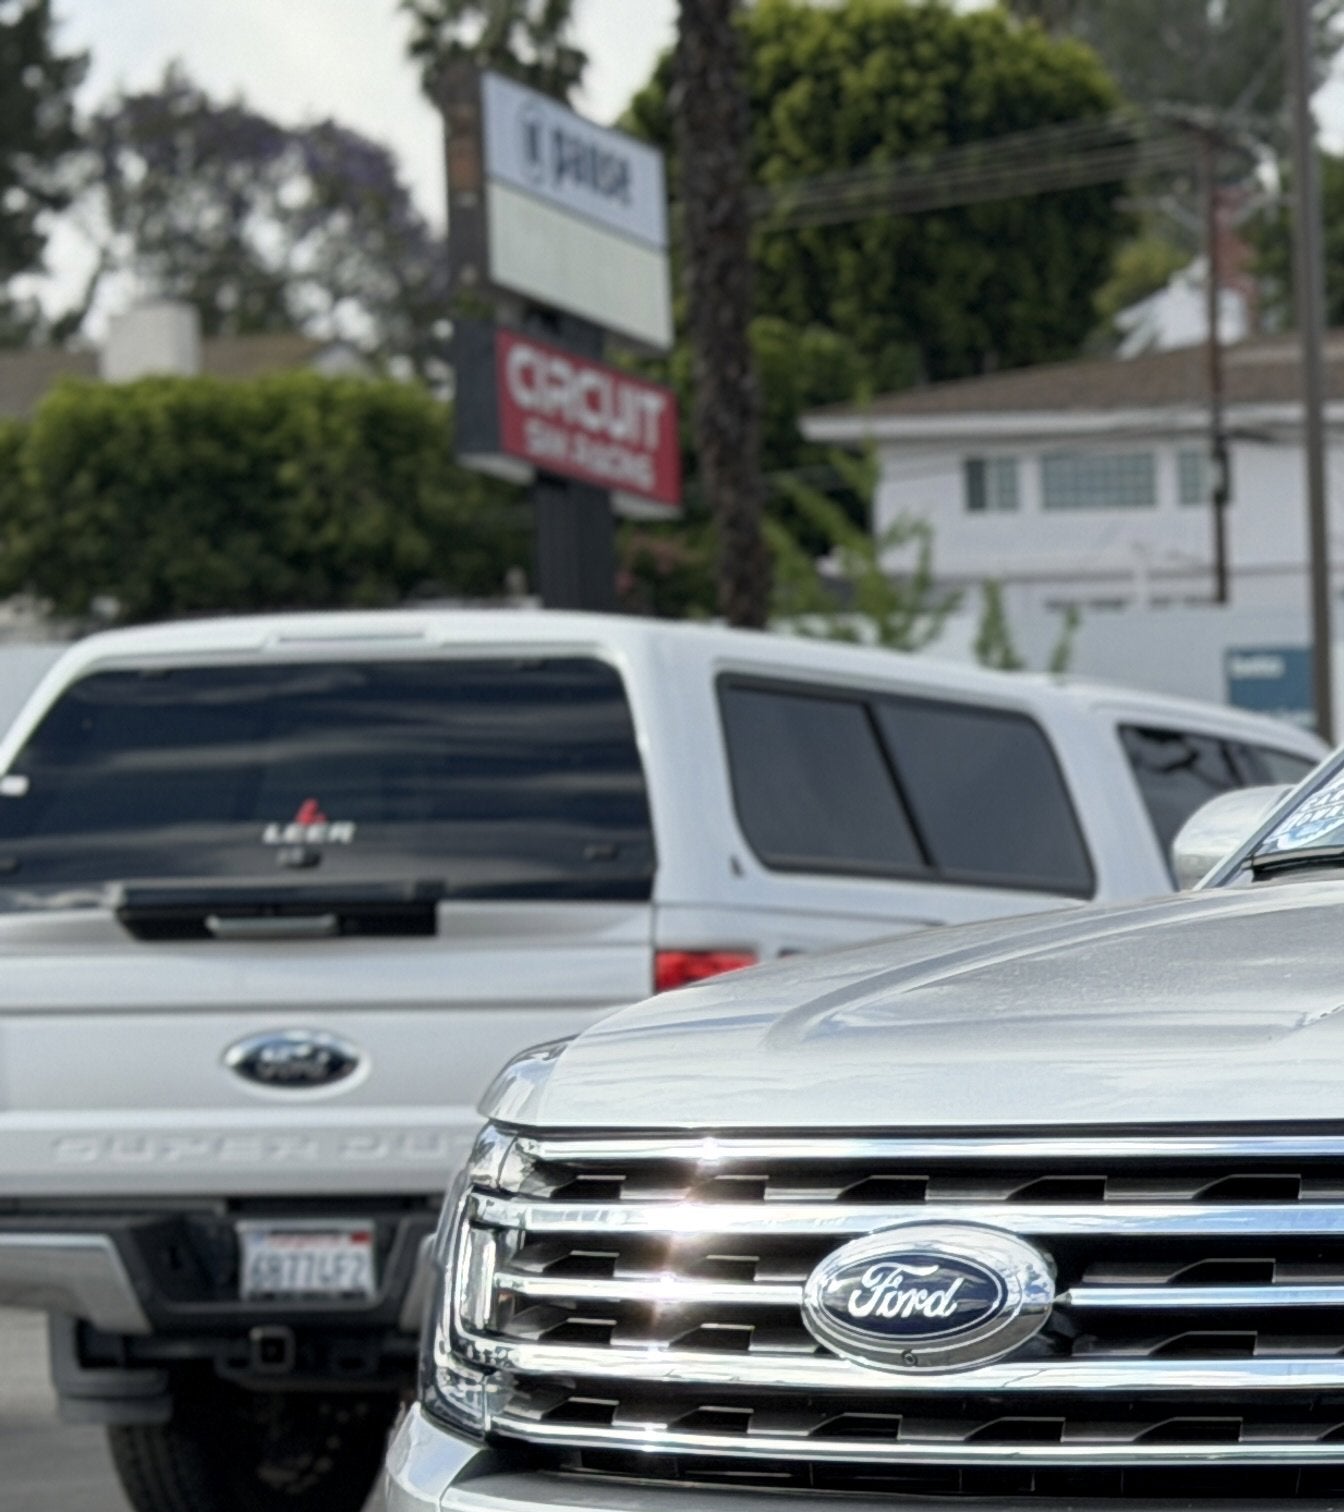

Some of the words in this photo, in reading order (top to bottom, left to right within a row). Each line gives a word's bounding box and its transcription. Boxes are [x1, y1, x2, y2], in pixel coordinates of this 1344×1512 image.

[507, 344, 666, 452] CIRCUIT
[262, 820, 357, 845] LEER
[52, 1131, 319, 1163] SUPER
[847, 1261, 964, 1319] Ford
